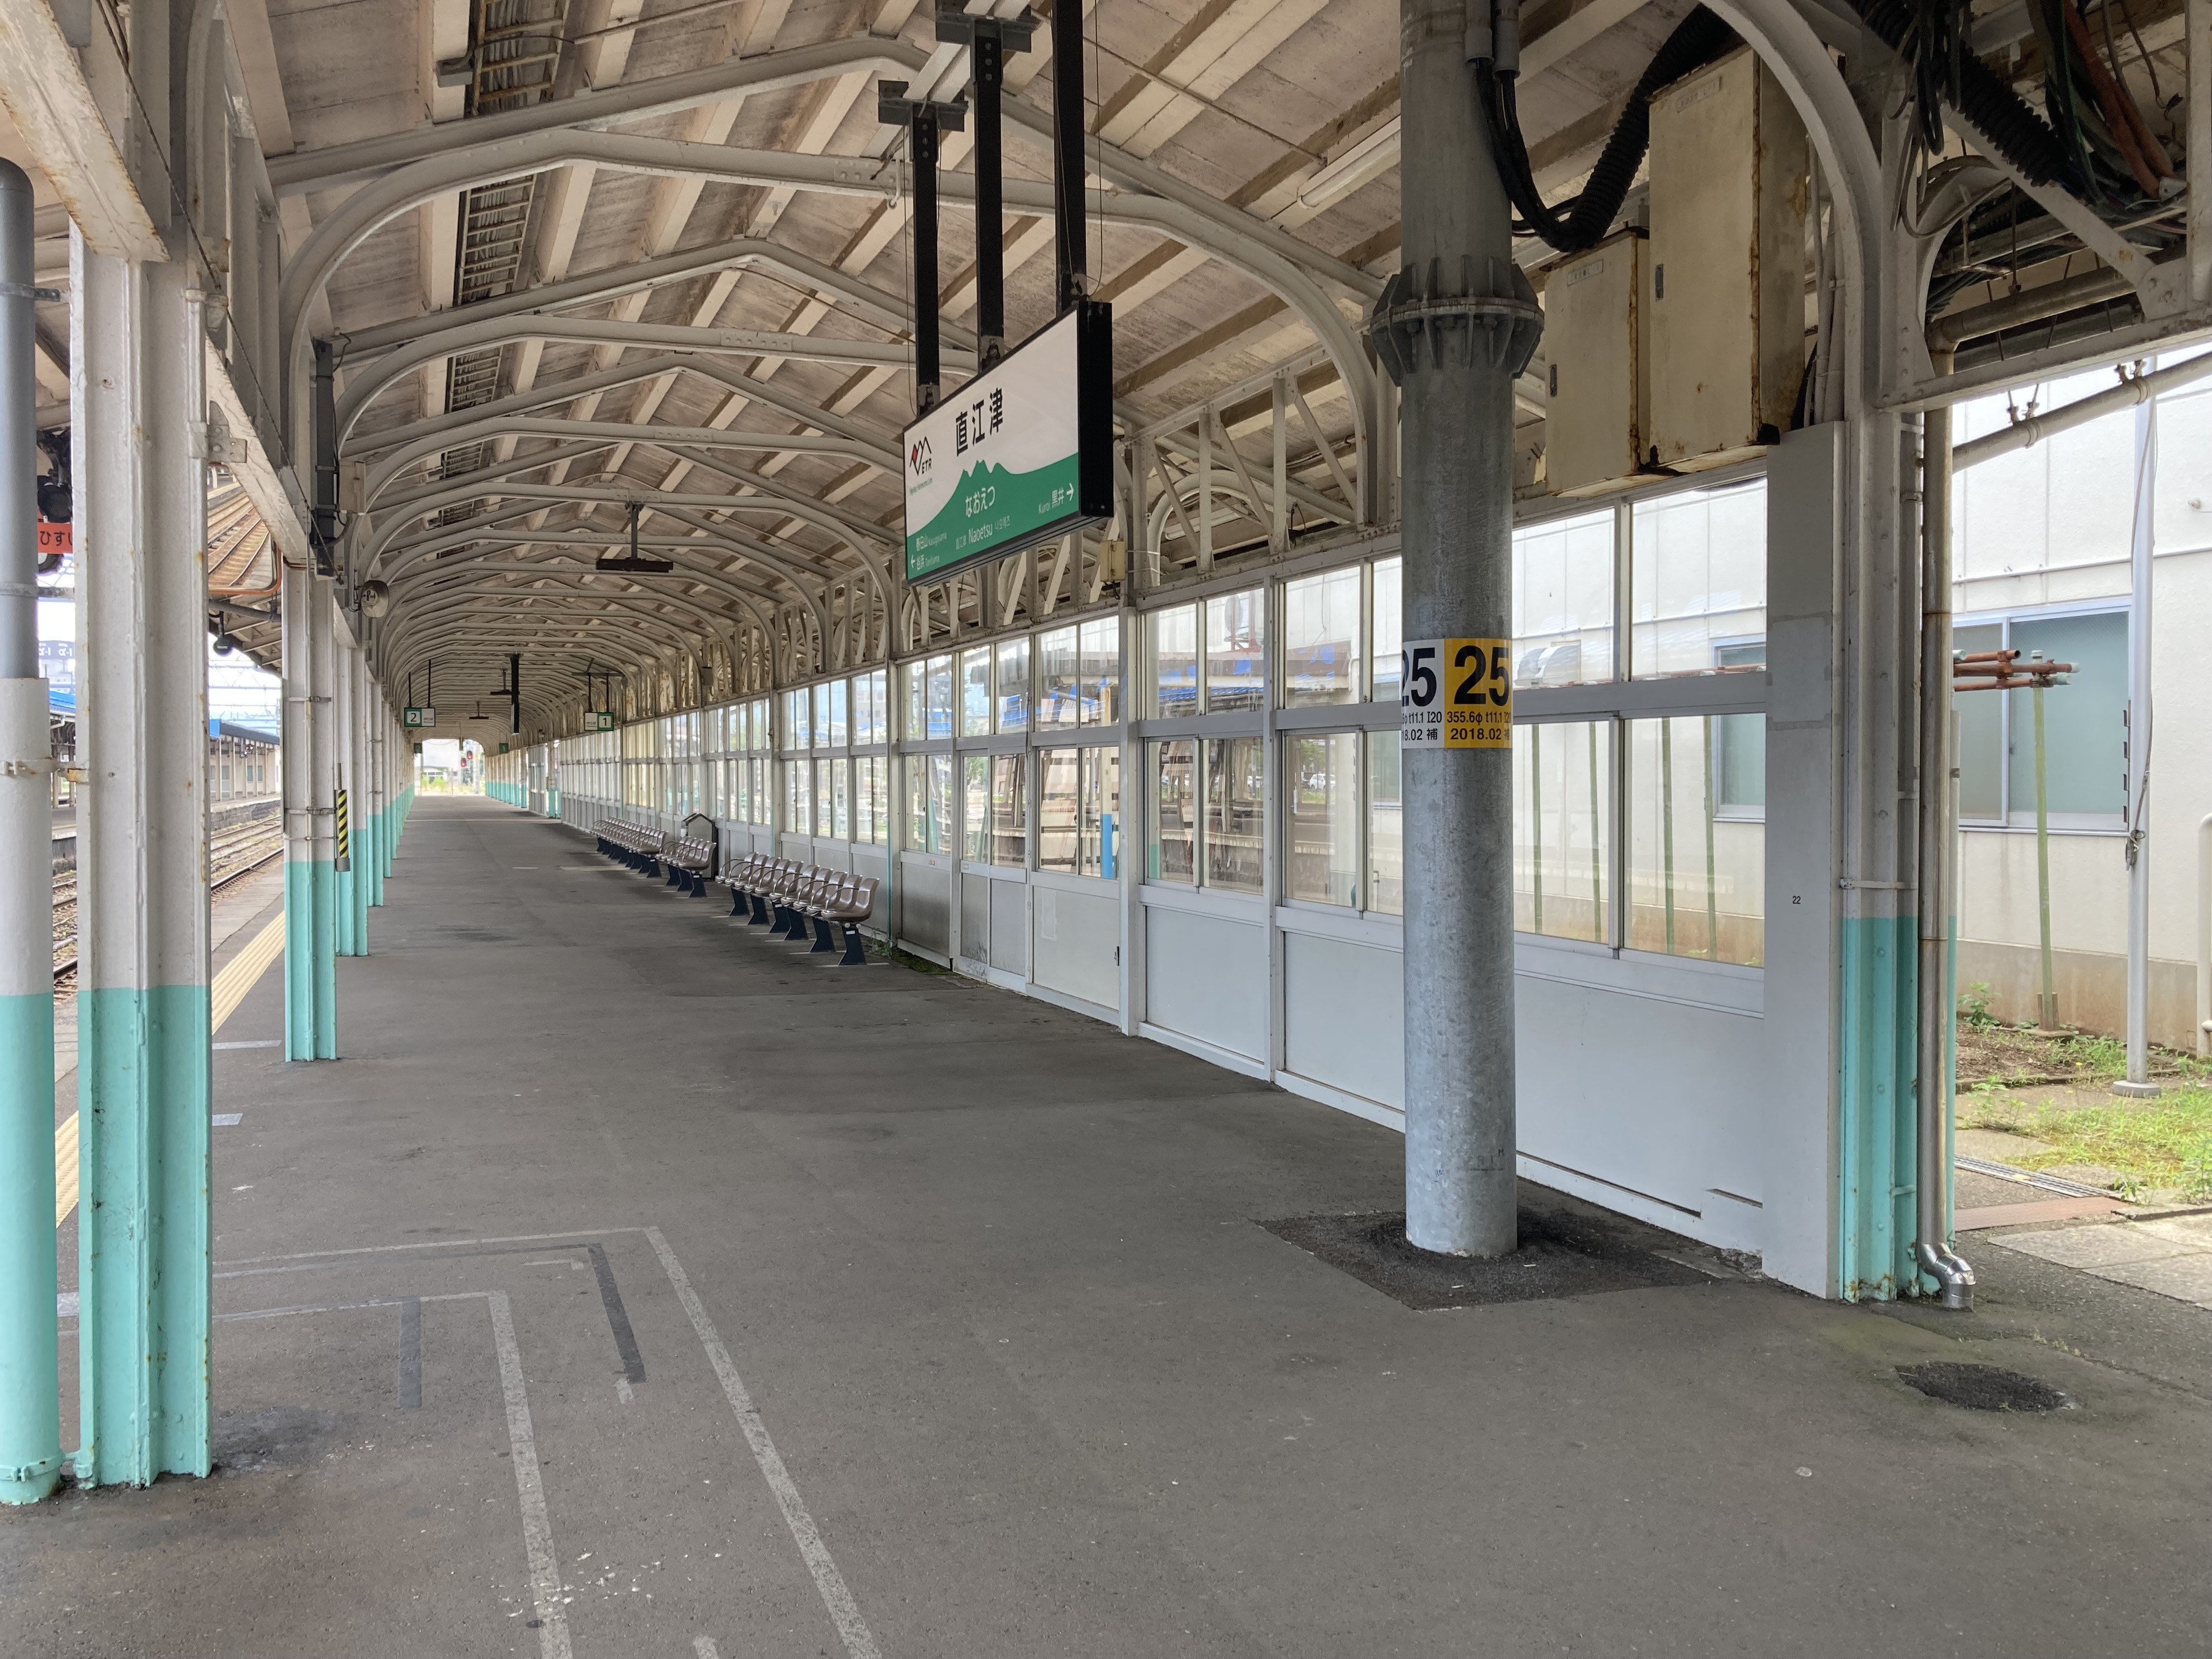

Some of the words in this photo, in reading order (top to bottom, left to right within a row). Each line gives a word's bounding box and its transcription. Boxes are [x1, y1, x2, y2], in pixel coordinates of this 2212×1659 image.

[956, 387, 1003, 456] 直江津
[922, 458, 932, 475] ETR
[966, 486, 995, 518] なおえつ
[1039, 503, 1051, 514] Kuroi
[1052, 487, 1064, 509] 黒井
[969, 523, 993, 545] Naoetsu
[1454, 645, 1509, 707] 25
[410, 713, 417, 723] 2
[603, 717, 607, 726] 1
[1427, 728, 1438, 741] 補
[1451, 727, 1502, 740] 2018.02
[1792, 895, 1801, 905] 22
